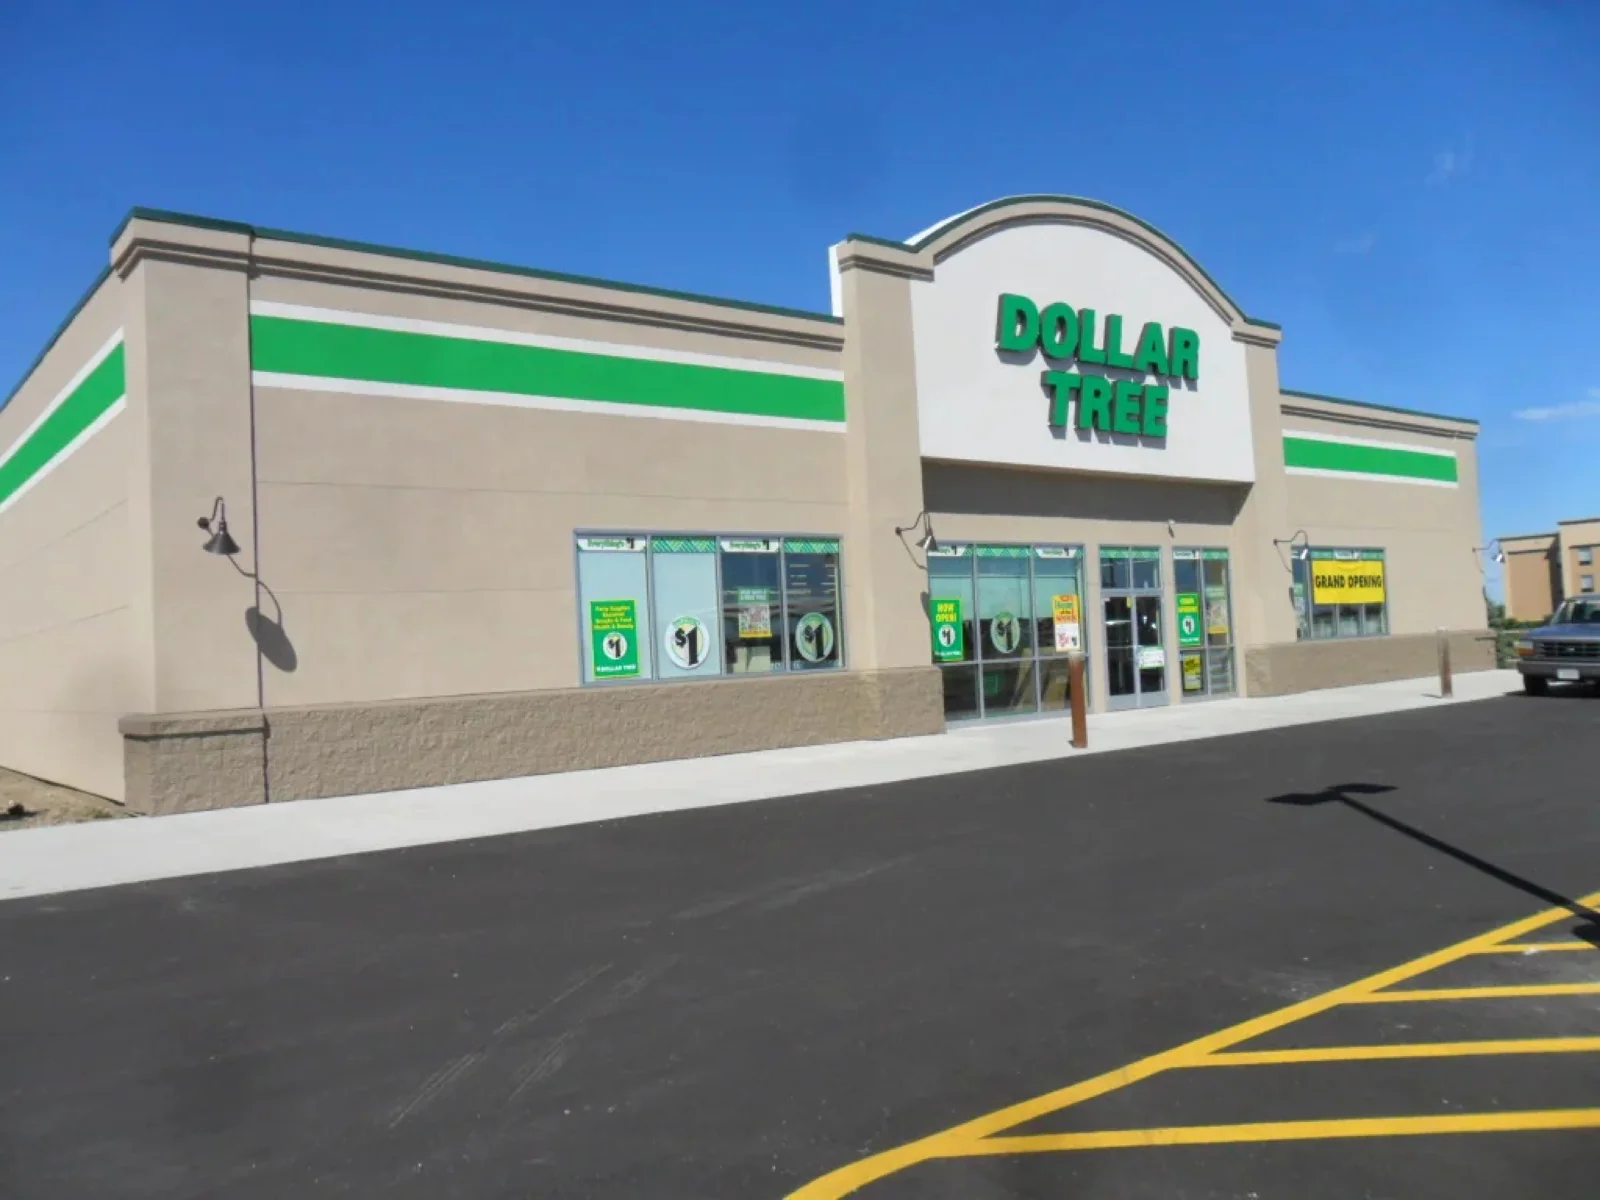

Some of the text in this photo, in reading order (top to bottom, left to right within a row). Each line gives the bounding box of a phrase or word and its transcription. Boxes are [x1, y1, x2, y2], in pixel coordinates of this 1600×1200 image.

[998, 293, 1200, 380] DOLLAR
[1041, 369, 1169, 438] TREE
[1315, 575, 1382, 588] GRAND OPENING
[675, 627, 699, 666] $1
[804, 624, 824, 660] $1
